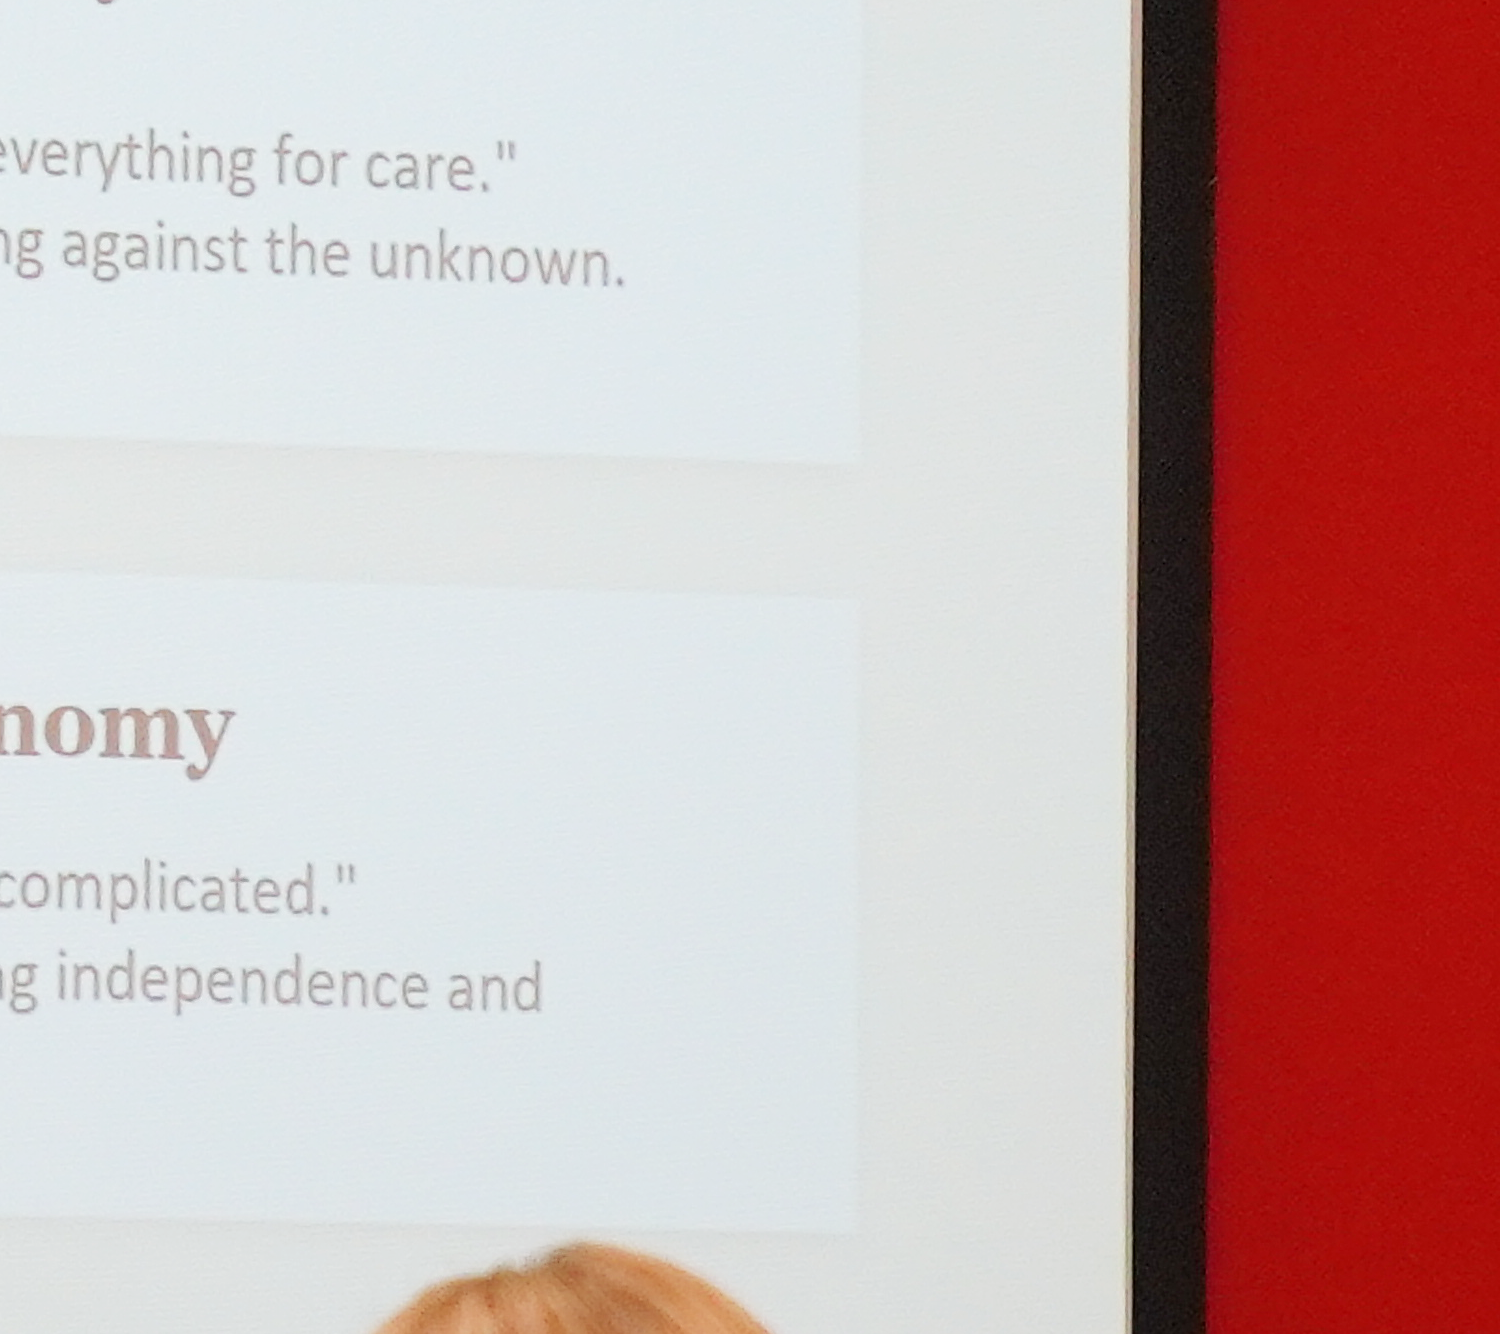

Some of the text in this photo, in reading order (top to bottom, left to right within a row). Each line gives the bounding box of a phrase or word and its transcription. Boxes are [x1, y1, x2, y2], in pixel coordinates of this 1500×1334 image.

[272, 131, 350, 188] for
[365, 140, 517, 193] care."
[61, 222, 248, 284] against
[266, 224, 351, 278] the
[370, 229, 626, 288] unknown.
[57, 947, 430, 1017] independence
[447, 959, 543, 1013] and
